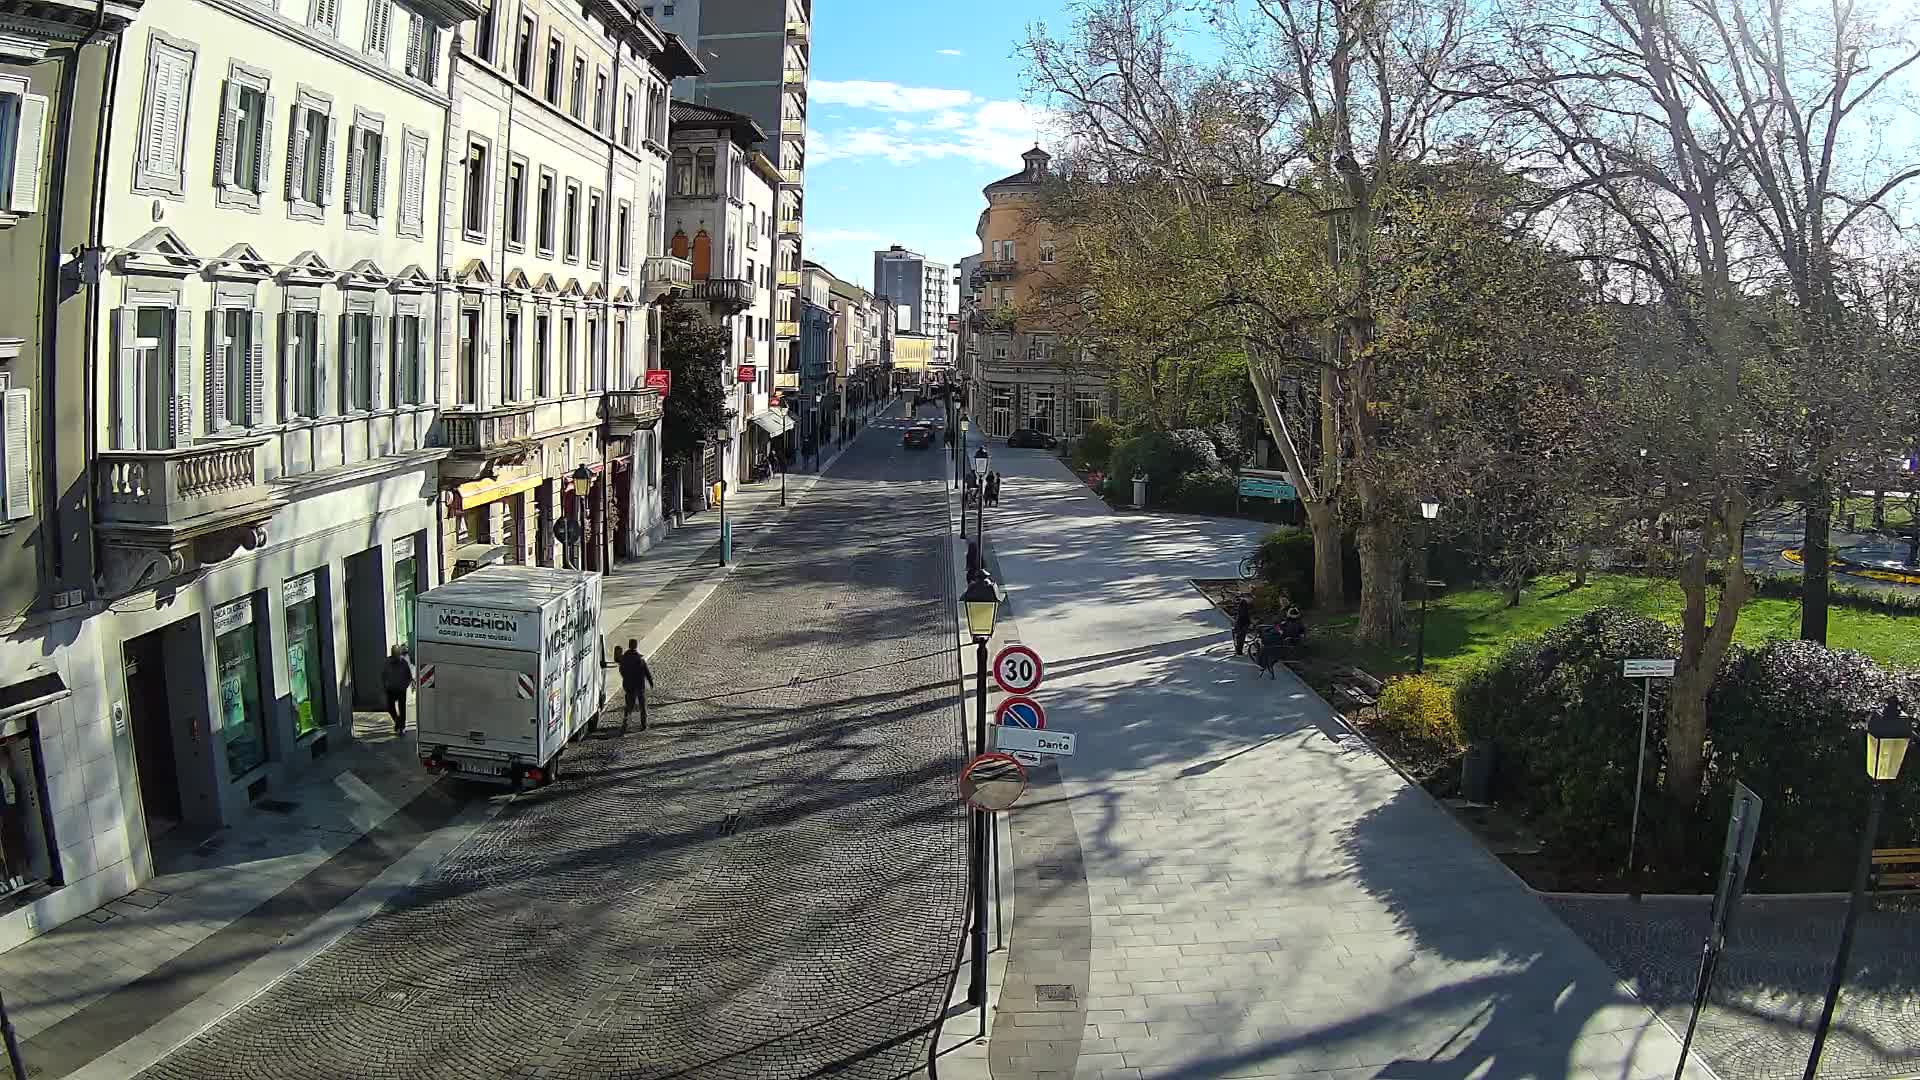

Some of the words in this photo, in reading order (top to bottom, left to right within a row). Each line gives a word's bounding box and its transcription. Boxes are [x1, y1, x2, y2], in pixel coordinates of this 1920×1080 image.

[439, 614, 517, 632] MOSCHION
[544, 606, 595, 662] MOSCHION
[1005, 659, 1032, 682] 30
[1038, 739, 1069, 750] Dante
